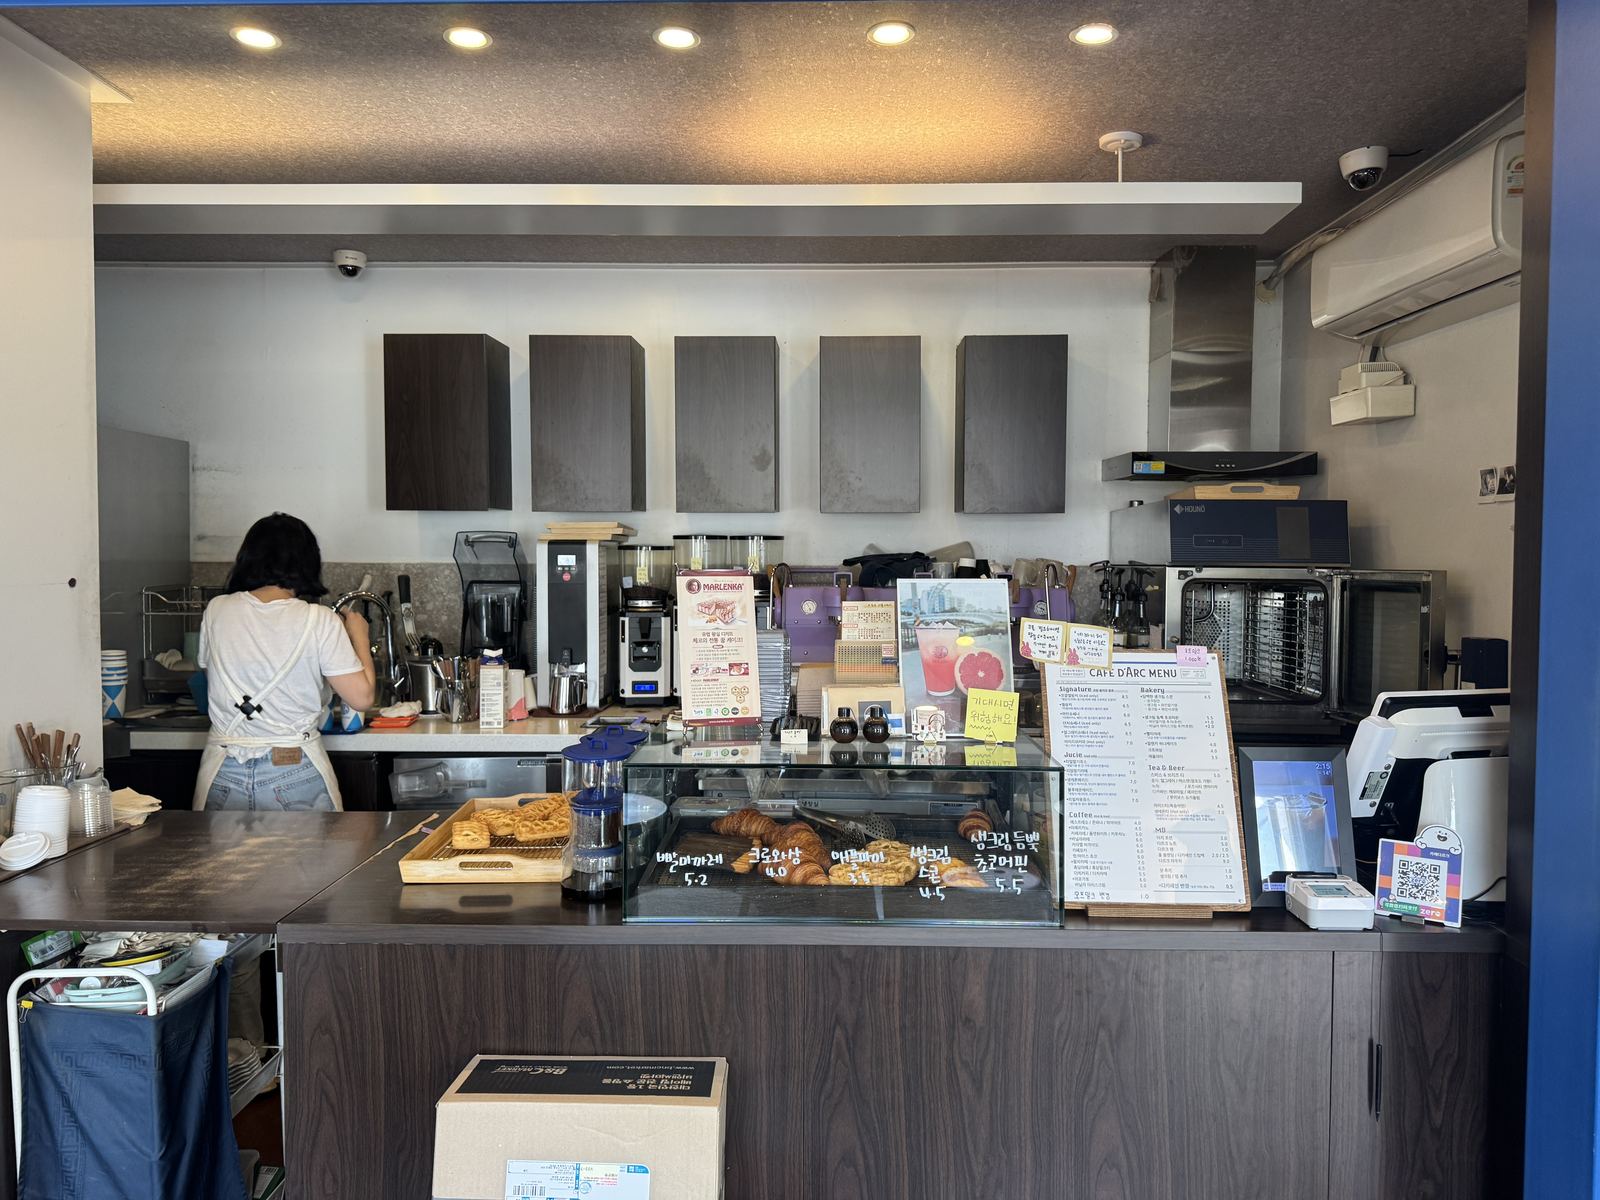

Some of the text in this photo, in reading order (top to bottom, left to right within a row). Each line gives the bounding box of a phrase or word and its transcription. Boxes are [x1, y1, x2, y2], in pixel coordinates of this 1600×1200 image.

[1149, 669, 1177, 678] MENU
[972, 697, 1015, 711] 기대시면
[748, 847, 802, 865] 크로와상
[831, 848, 885, 870] 애플파이
[973, 854, 1028, 873] 초코머핀
[766, 866, 788, 878] 4.0
[848, 872, 870, 885] 3.5
[918, 865, 941, 884] 스콘
[684, 873, 708, 886] 5.2
[995, 878, 1022, 895] 5.5
[919, 886, 946, 901] 4.5
[1420, 908, 1441, 917] zero
